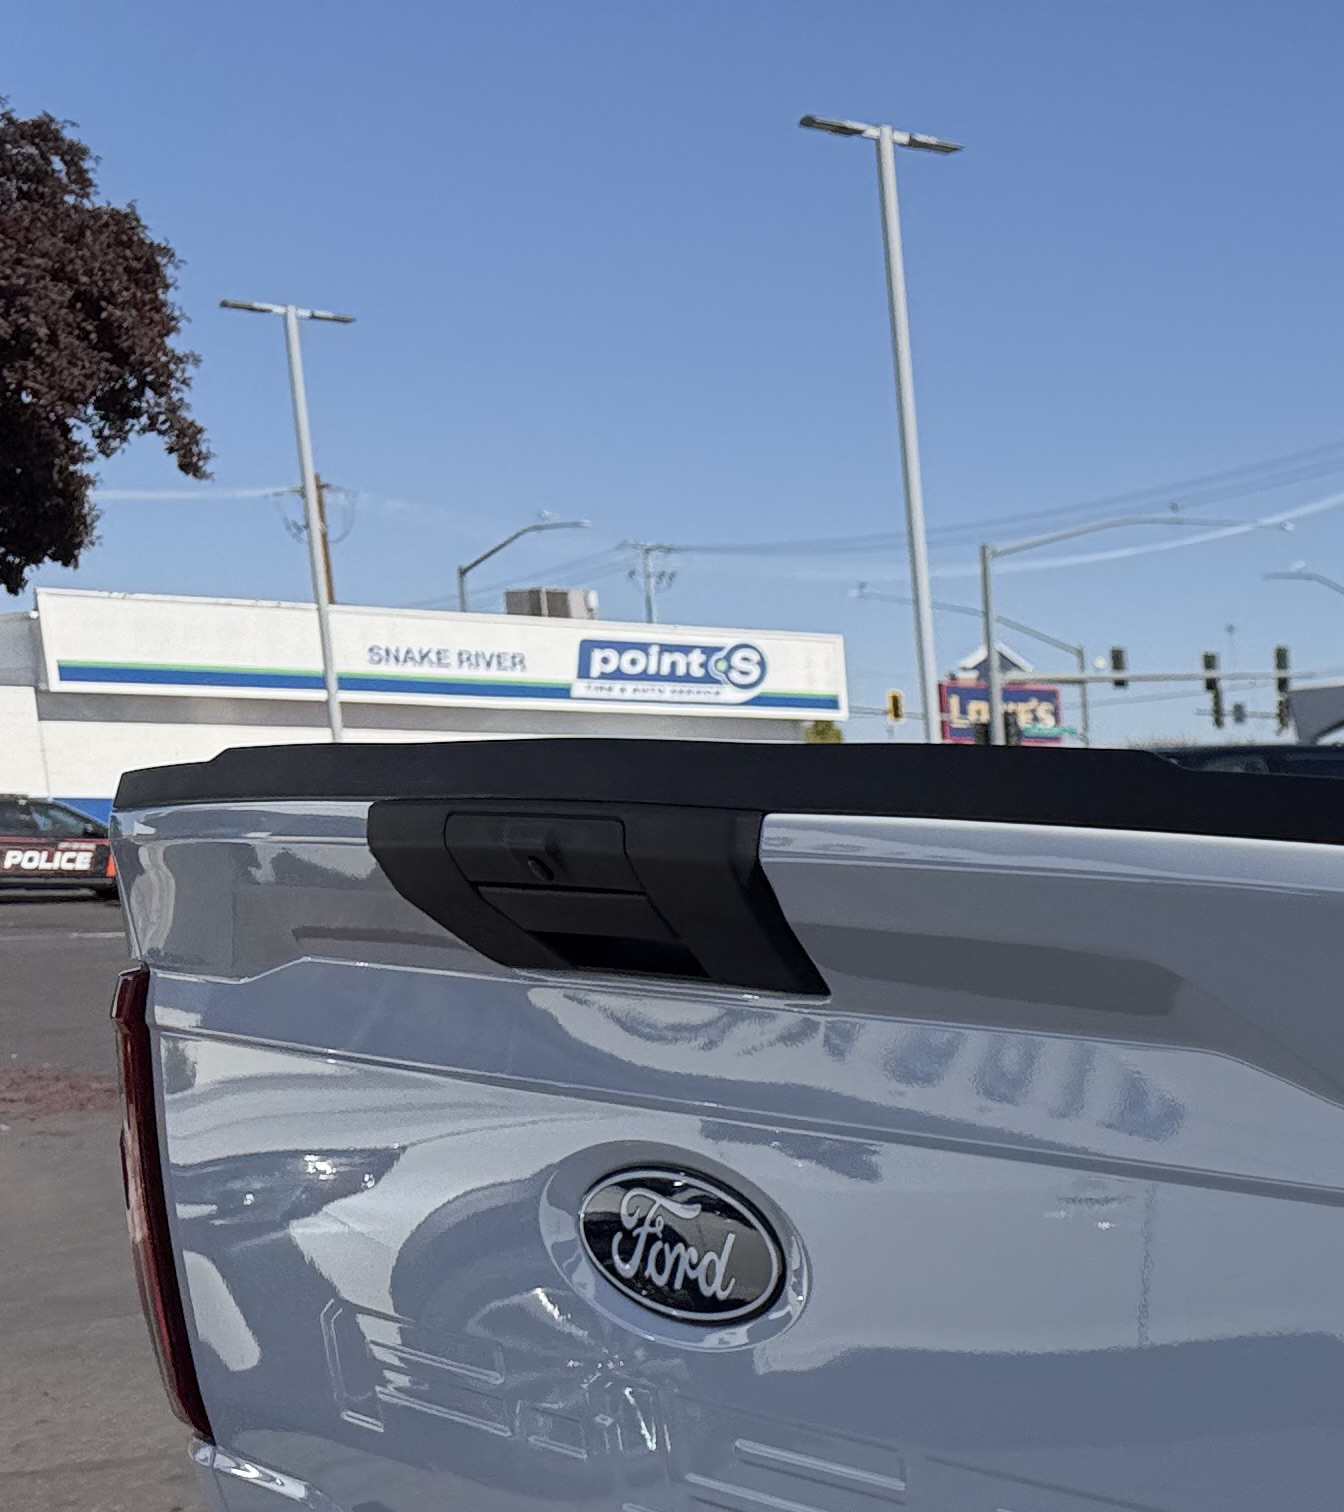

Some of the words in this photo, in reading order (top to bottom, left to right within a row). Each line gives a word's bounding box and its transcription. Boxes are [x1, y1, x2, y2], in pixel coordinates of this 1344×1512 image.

[367, 644, 451, 669] SNAKE
[457, 649, 528, 672] RIVER
[589, 644, 707, 679] point
[726, 647, 761, 685] S
[3, 850, 94, 871] POLICE
[611, 1186, 736, 1301] Ford
